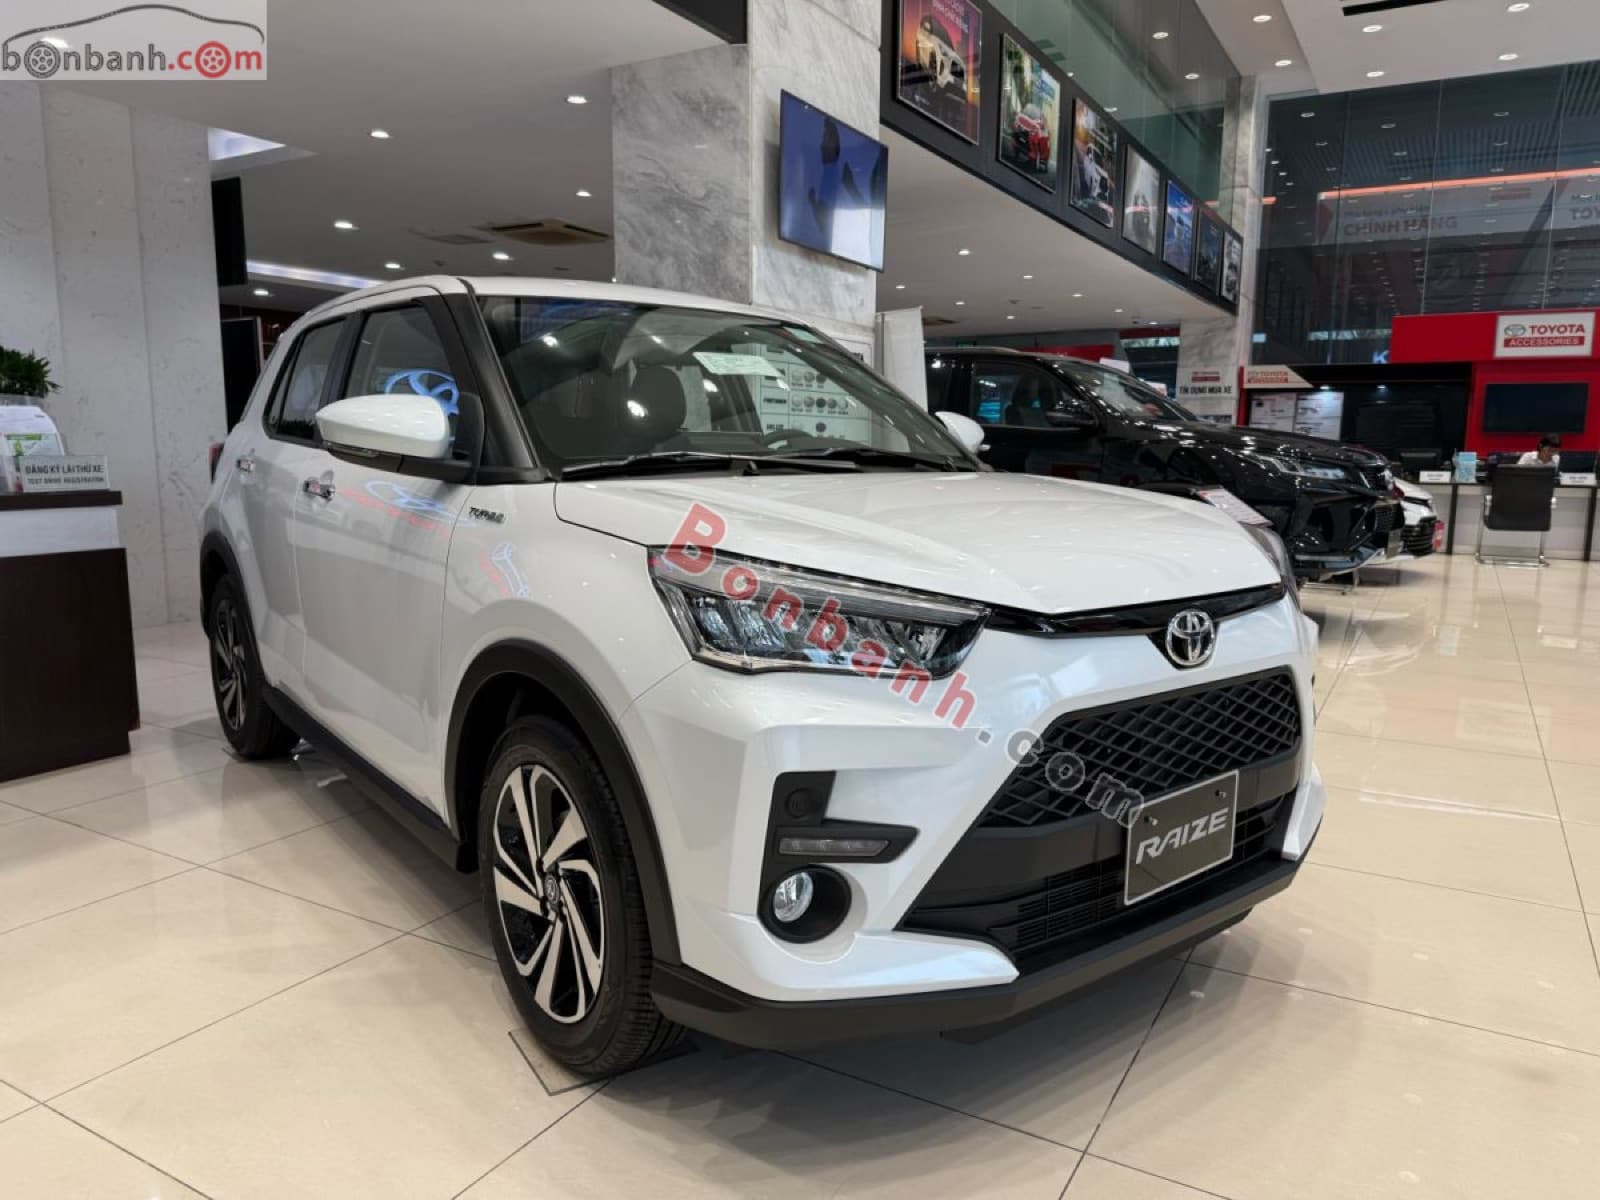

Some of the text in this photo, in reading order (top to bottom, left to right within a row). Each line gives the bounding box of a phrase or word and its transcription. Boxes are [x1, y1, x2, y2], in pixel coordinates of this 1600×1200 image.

[1529, 323, 1585, 336] TOYOTA
[1509, 337, 1578, 347] ACCESSORIES
[92, 464, 105, 473] XE
[1135, 807, 1229, 865] RAIZE
